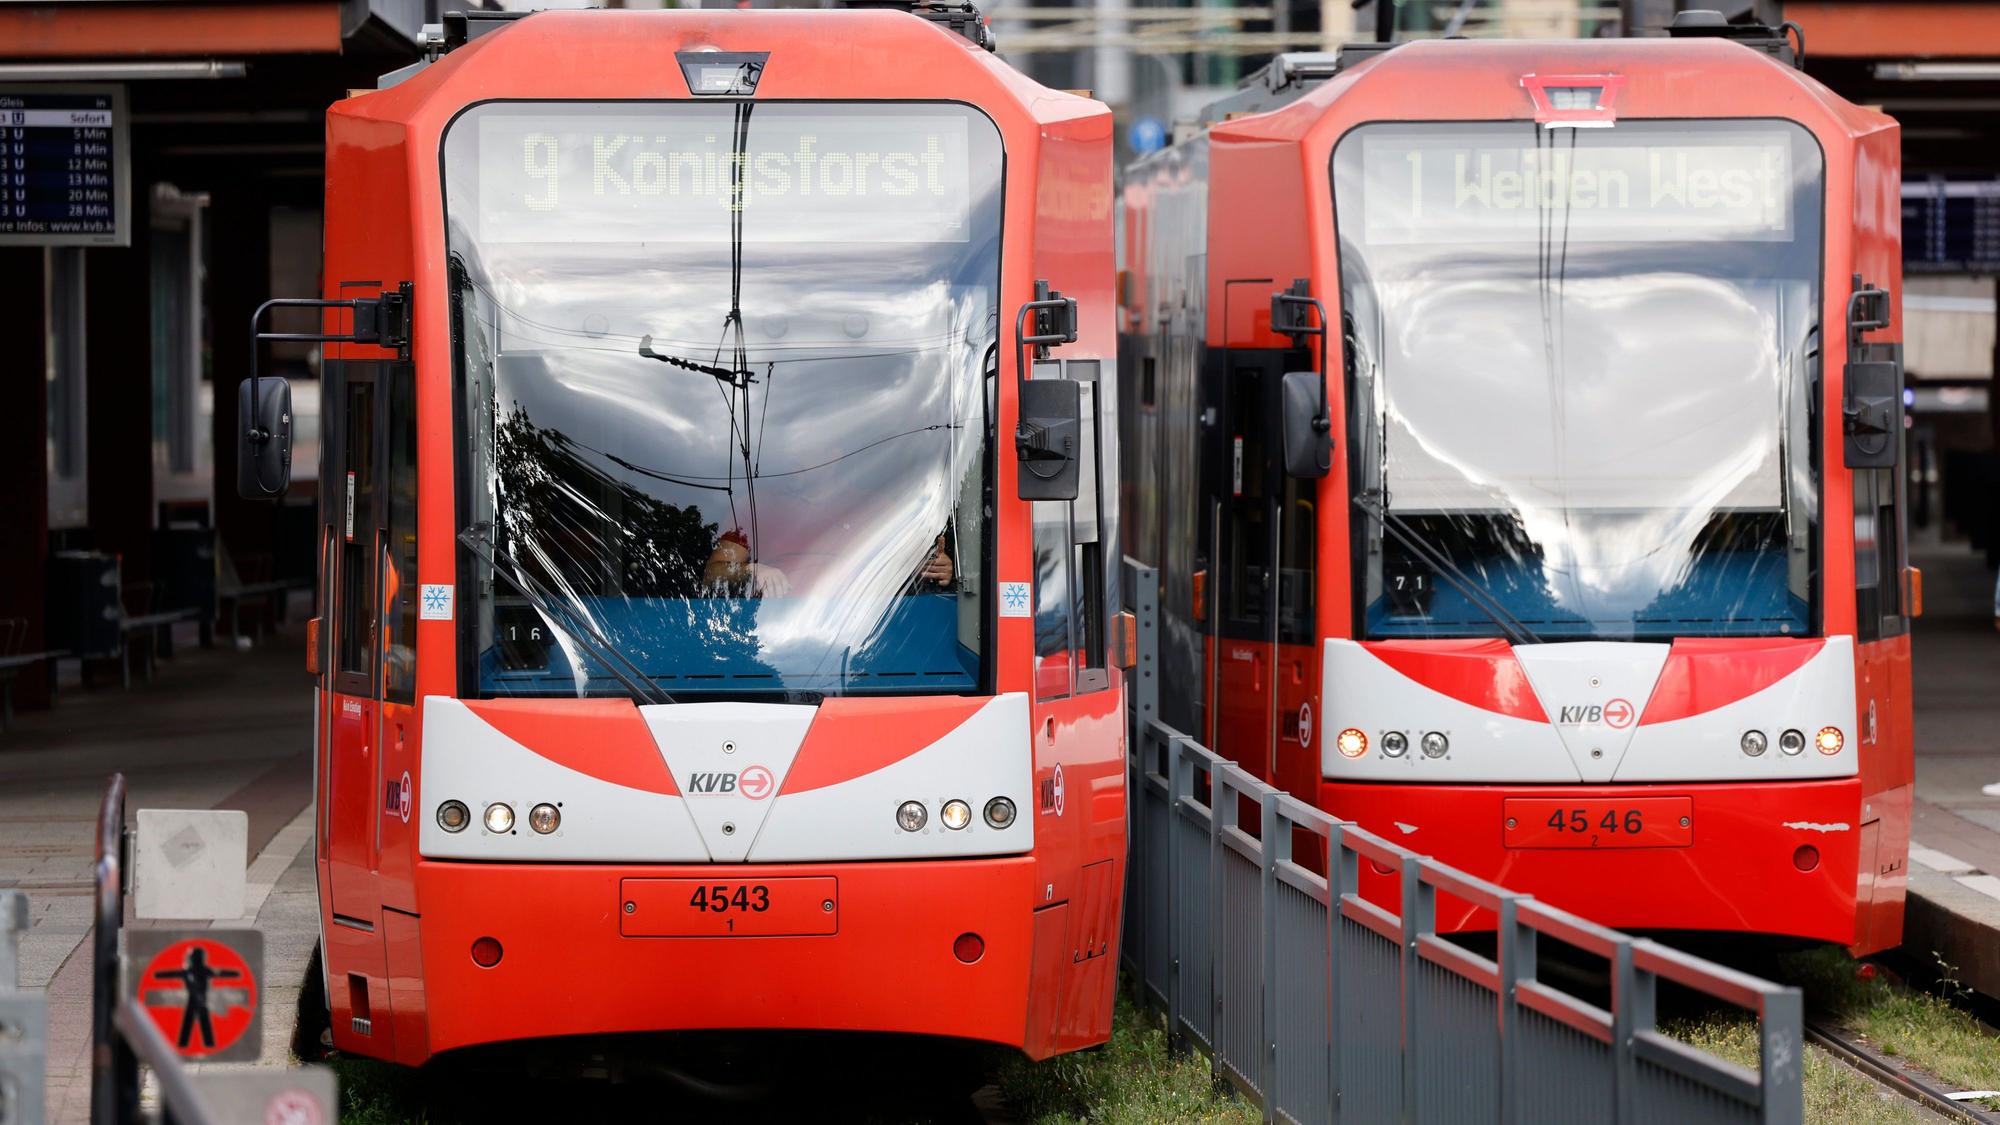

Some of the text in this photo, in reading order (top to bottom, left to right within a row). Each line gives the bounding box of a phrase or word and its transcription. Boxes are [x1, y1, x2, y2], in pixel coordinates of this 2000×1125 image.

[96, 98, 106, 108] in
[70, 113, 106, 124] Sofort
[84, 128, 106, 139] Min
[84, 143, 107, 155] Min
[68, 159, 81, 170] 12
[85, 158, 107, 170] Min
[523, 134, 945, 212] 9 Königsforst
[68, 174, 82, 185] 13
[85, 174, 108, 185] Min
[1406, 149, 1777, 219] 1 Weiden West
[68, 190, 82, 201] 20
[85, 189, 108, 201] Min
[69, 206, 82, 216] 28
[86, 205, 108, 216] Min
[0, 222, 14, 232] re
[1559, 705, 1602, 723] KVB
[688, 772, 737, 793] KVB
[386, 780, 401, 810] KVB
[690, 885, 770, 913] 4543
[726, 919, 734, 932] 1
